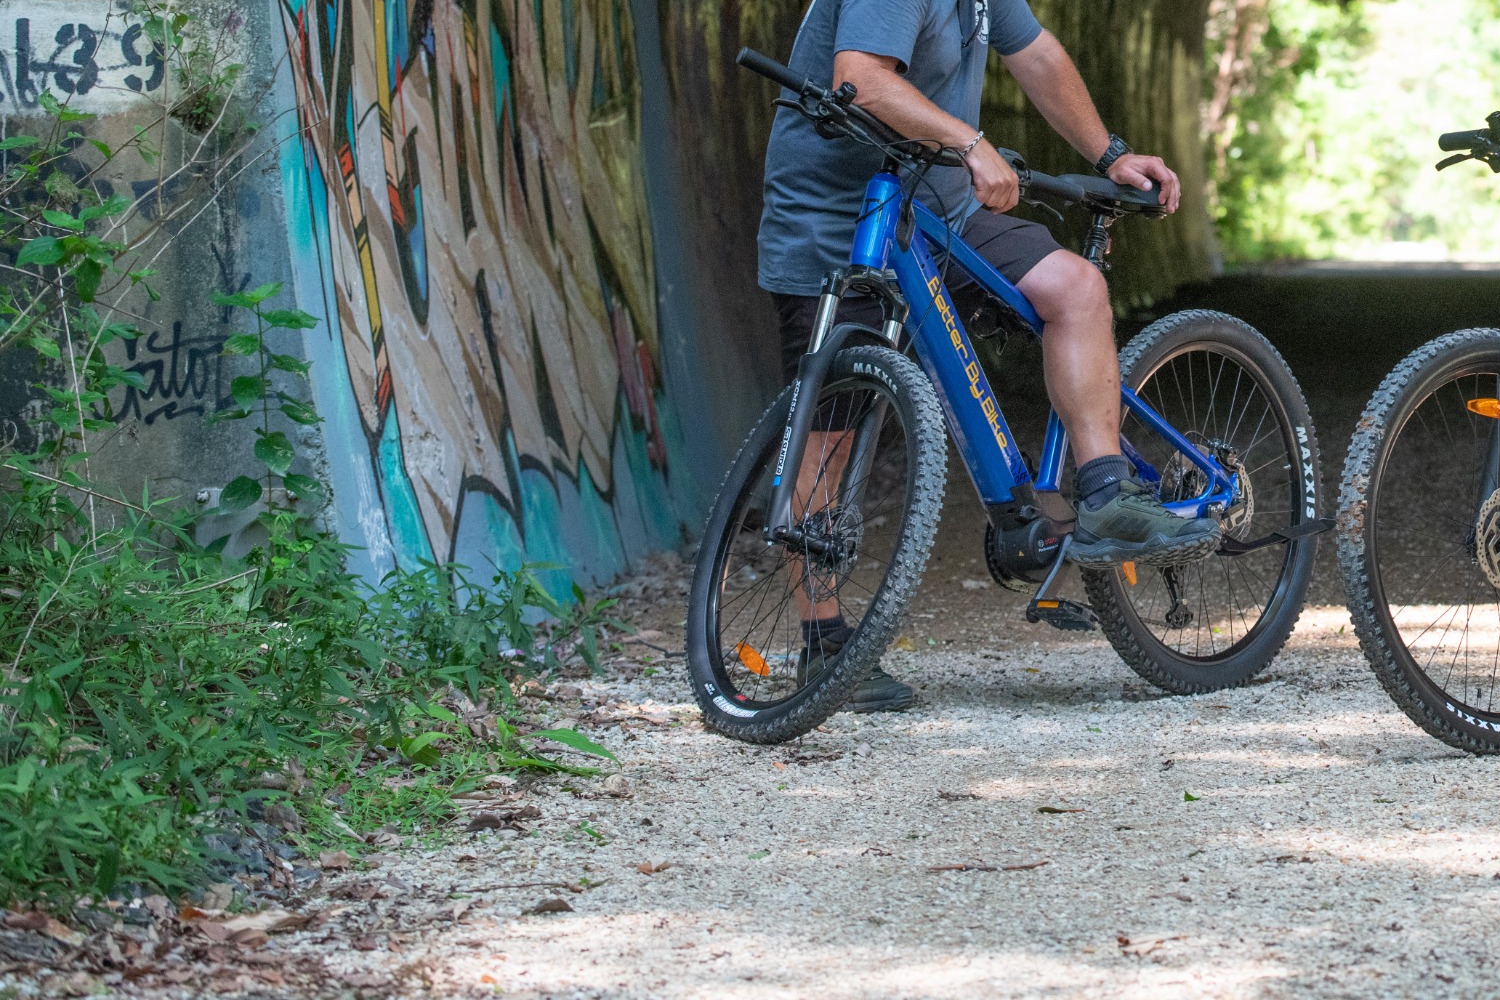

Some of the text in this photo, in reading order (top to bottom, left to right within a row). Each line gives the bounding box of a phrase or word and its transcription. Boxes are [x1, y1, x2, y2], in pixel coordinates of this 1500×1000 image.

[853, 362, 898, 395] MAXXIS
[927, 276, 1008, 450] Better By Bike
[1296, 426, 1316, 519] MAXXIS
